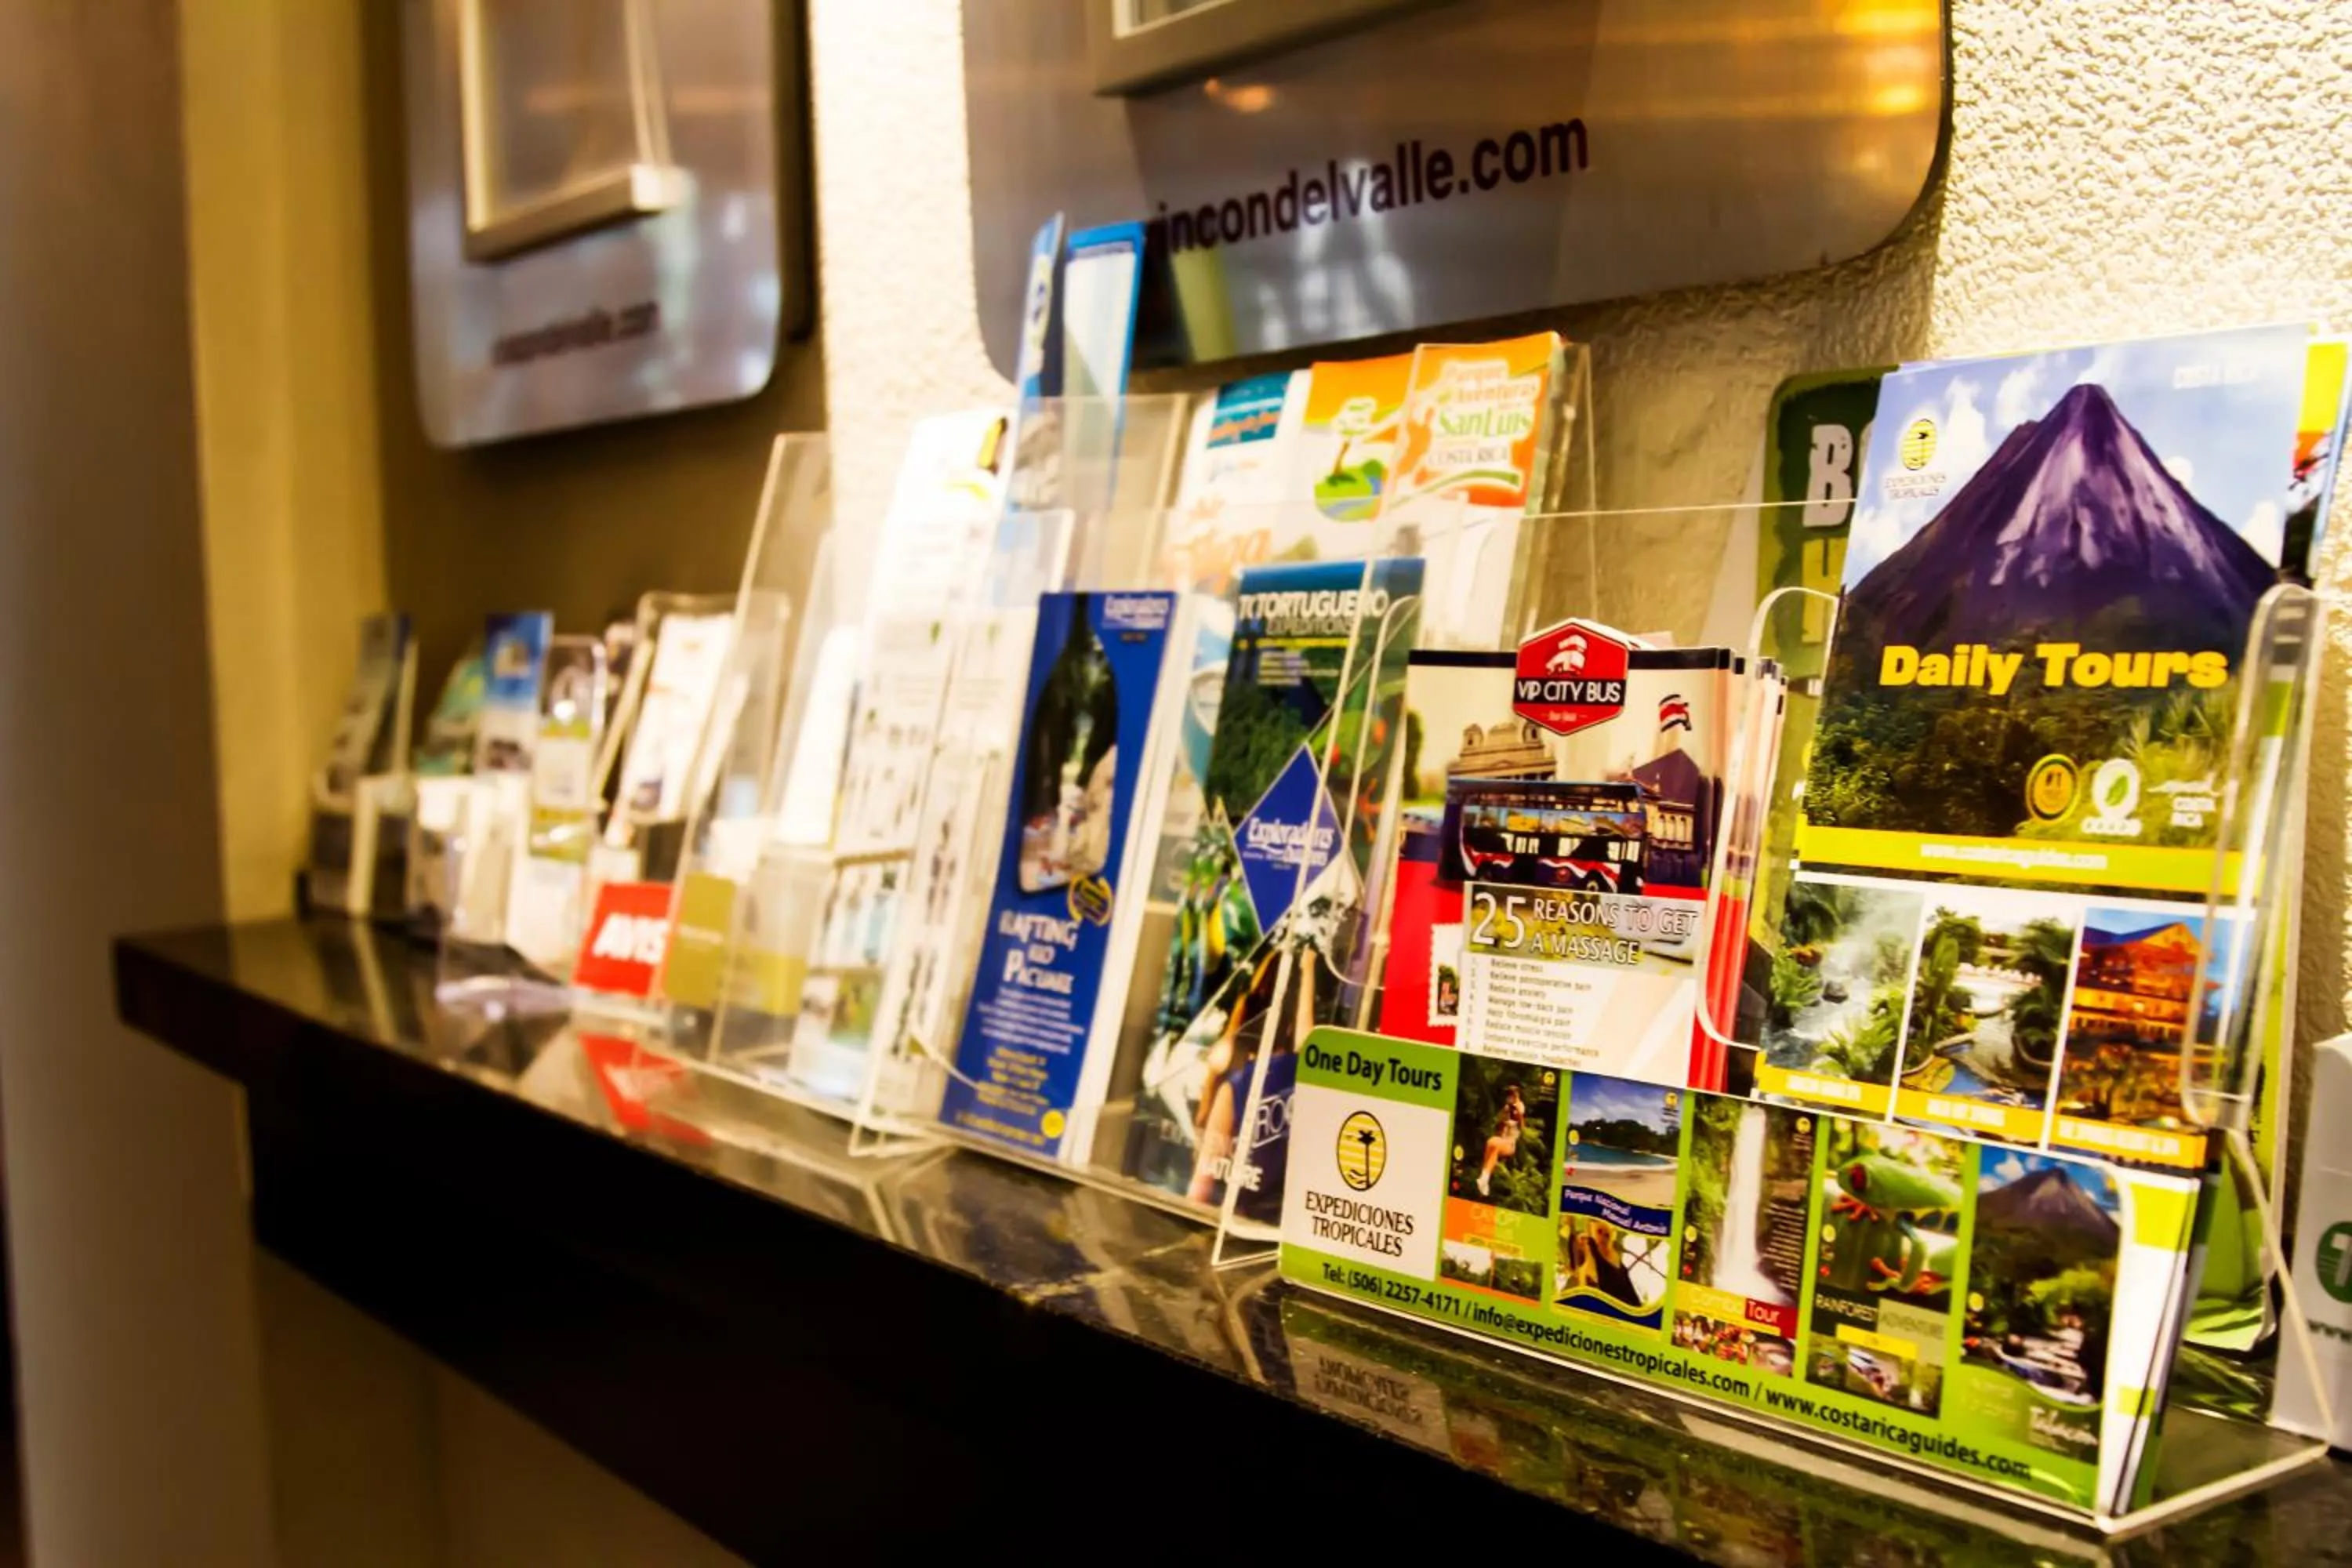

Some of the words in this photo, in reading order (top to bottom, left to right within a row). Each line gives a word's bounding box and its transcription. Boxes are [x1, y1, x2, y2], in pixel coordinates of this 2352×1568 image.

[1149, 118, 1589, 255] incondelvalle.com
[1879, 643, 2024, 695] Daily
[2035, 642, 2228, 688] Tours
[1517, 681, 1541, 701] VIP
[1544, 681, 1584, 702] CITY
[1586, 681, 1622, 703] BUS
[1248, 818, 1335, 849] Exploradres
[1470, 891, 1527, 949] 25
[1533, 898, 1619, 929] REASONS
[1624, 903, 1654, 932] TO
[1658, 908, 1699, 937] GET
[1530, 931, 1545, 954] A
[1550, 933, 1640, 965] MASSAGE
[1305, 1044, 1341, 1073] One
[1347, 1051, 1385, 1087] Day
[1388, 1059, 1443, 1091] Tours
[1305, 1191, 1415, 1236] EXPEDICIONES
[1312, 1215, 1403, 1258] TROPICALES
[1747, 1300, 1781, 1324] Tour
[1322, 1262, 1345, 1285] Tel:
[1347, 1272, 1382, 1298] (506)
[1385, 1279, 1461, 1316] 2257-4171
[1473, 1305, 1750, 1399] info@expedicionestropicales.com
[1766, 1387, 2032, 1480] www.costaricaguides.com
